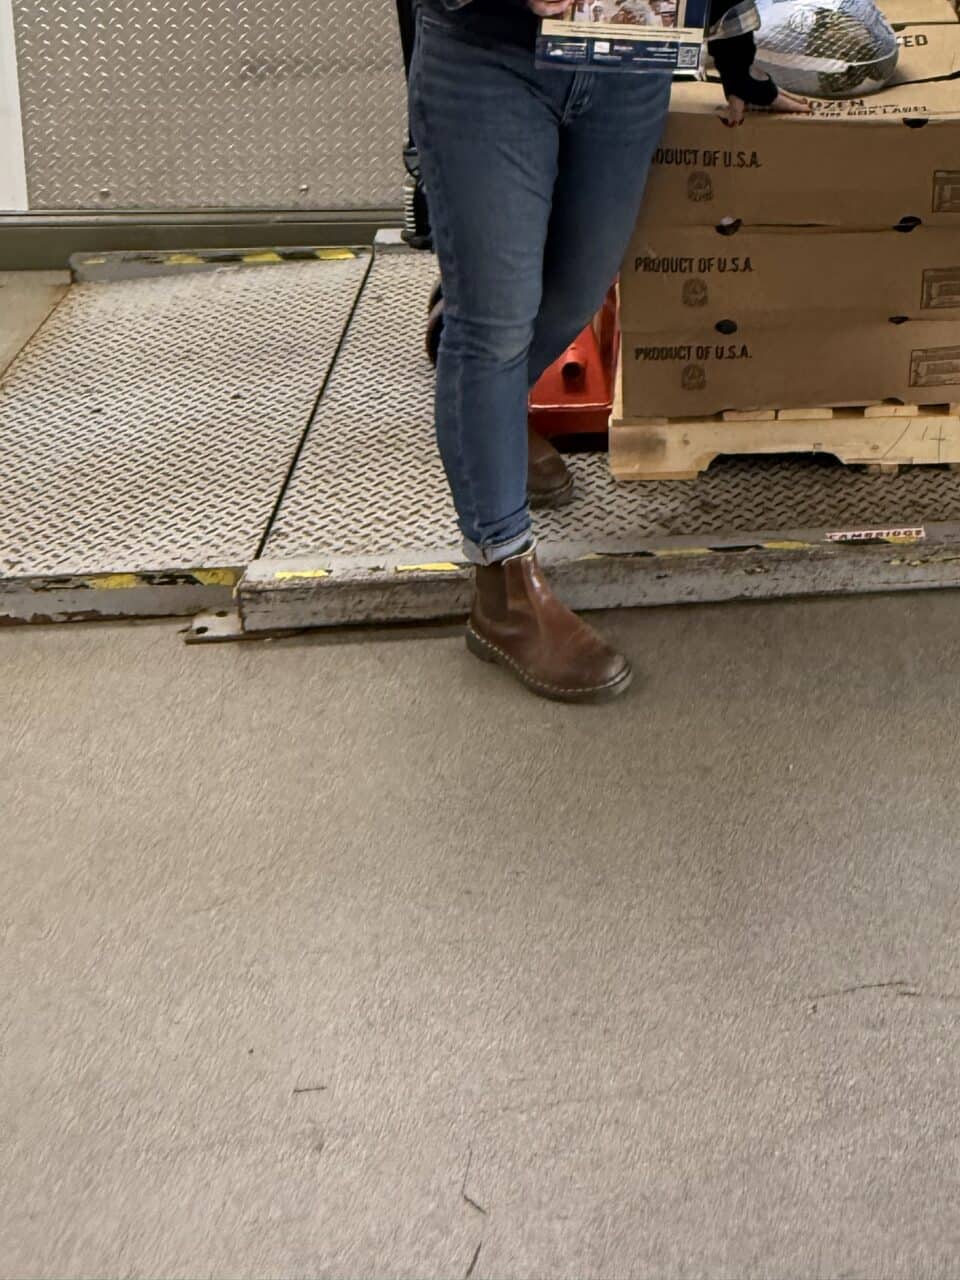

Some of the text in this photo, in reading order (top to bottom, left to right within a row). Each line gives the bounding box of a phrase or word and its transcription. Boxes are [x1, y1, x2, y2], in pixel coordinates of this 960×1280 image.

[808, 99, 864, 110] OZEN
[652, 148, 699, 166] ODUCT
[703, 150, 720, 167] OF
[635, 257, 694, 273] PRODUCT
[698, 257, 715, 273] OF
[635, 344, 752, 361] PRODUCT OF U.S.A.
